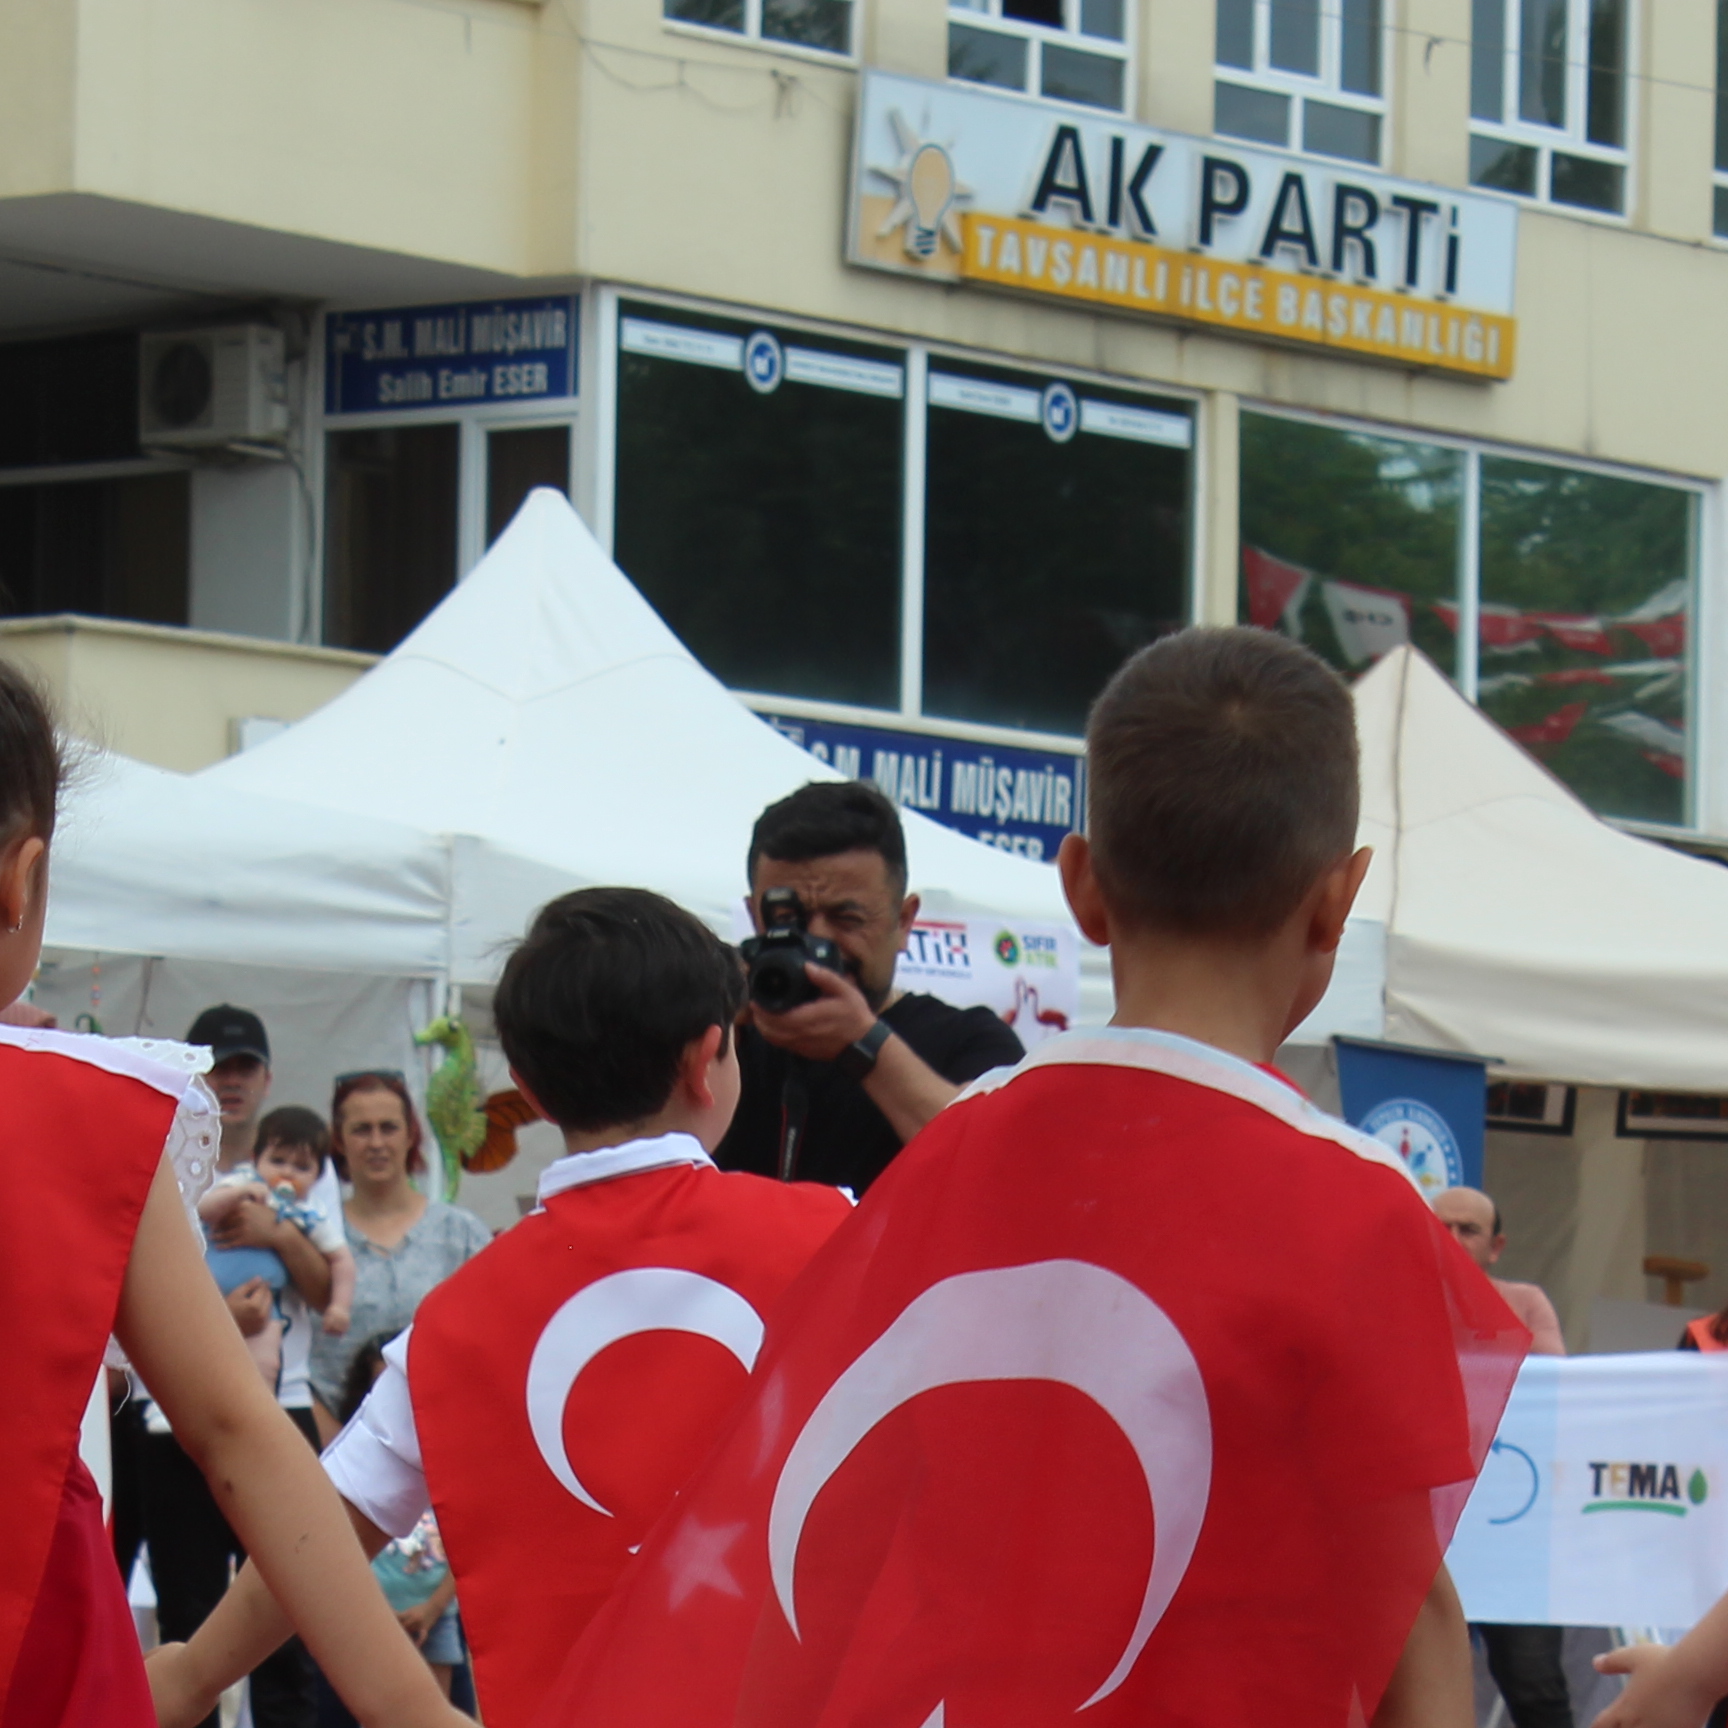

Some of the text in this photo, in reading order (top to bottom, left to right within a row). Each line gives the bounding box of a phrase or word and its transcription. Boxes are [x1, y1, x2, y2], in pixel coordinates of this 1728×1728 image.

[1029, 124, 1164, 240] AK
[975, 226, 1169, 301] TAVŞANLI
[1275, 286, 1501, 367] BAŞKANLIĞI
[493, 363, 549, 396] ESER
[874, 750, 943, 811] MALİ
[951, 756, 1073, 827] MÜŞAVİR
[1589, 1462, 1681, 1500] TEMA
